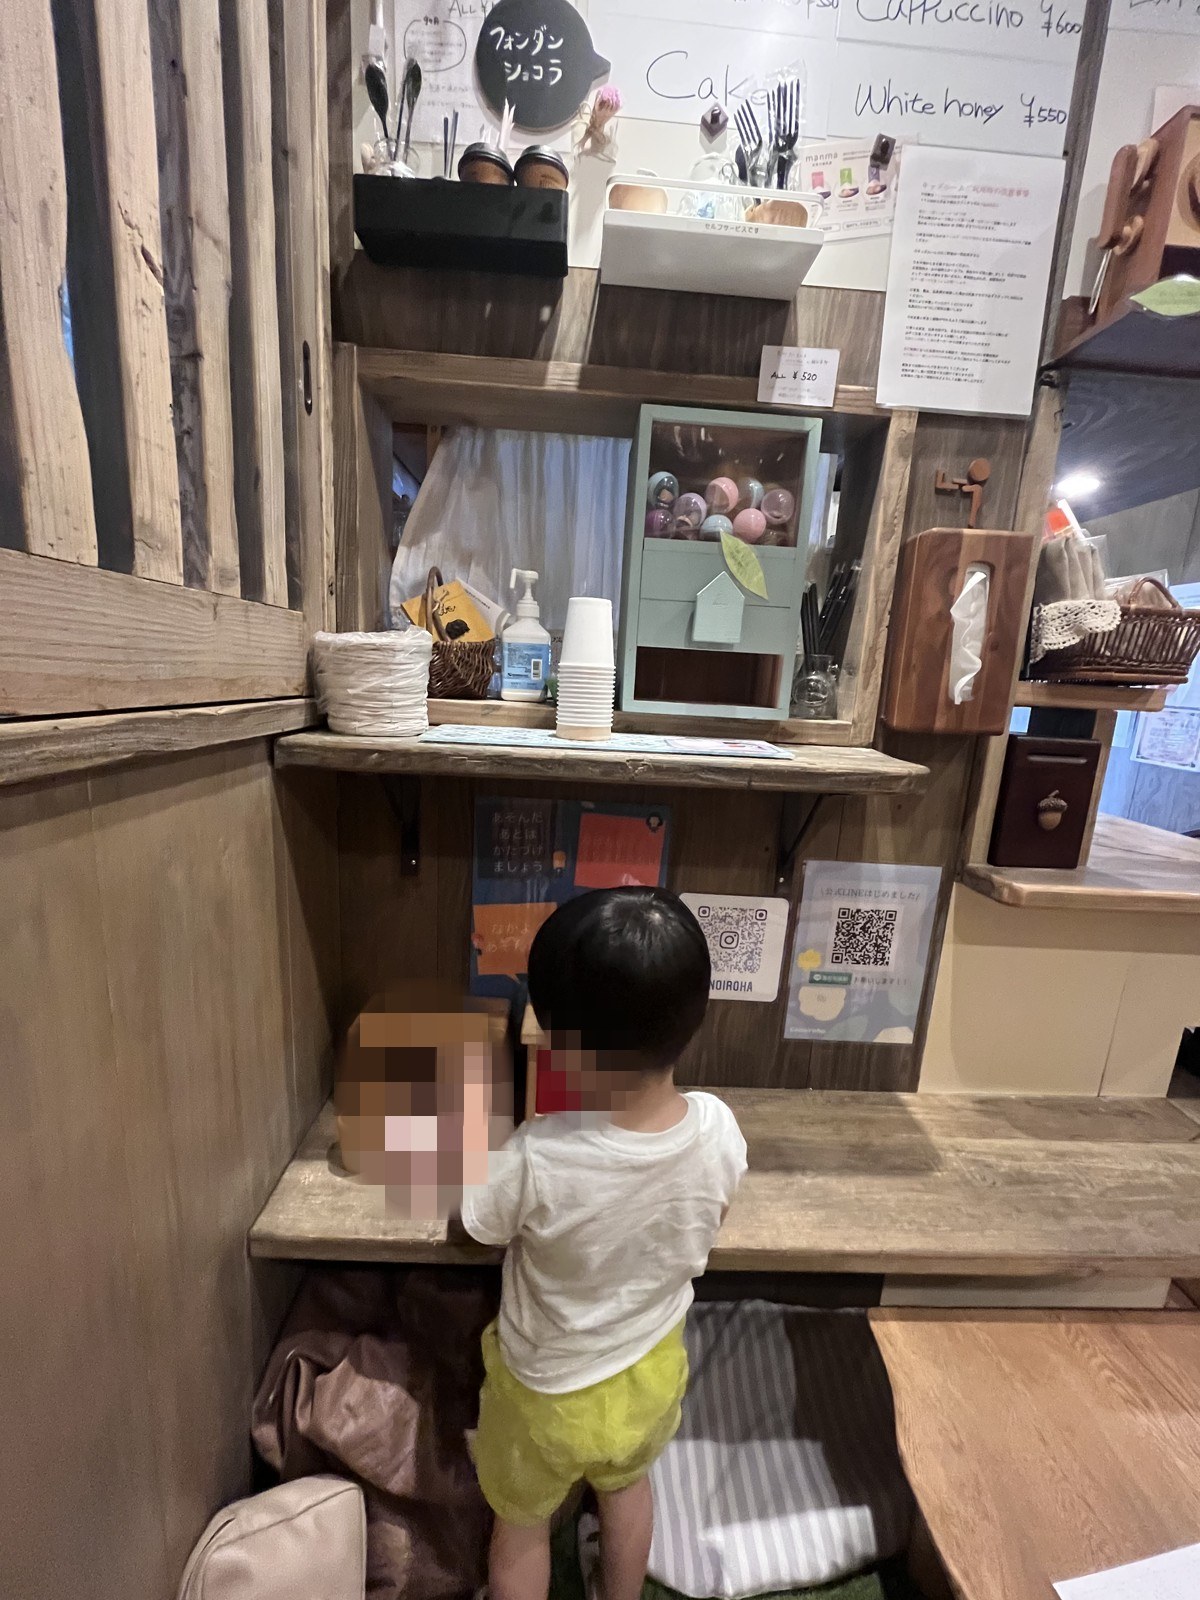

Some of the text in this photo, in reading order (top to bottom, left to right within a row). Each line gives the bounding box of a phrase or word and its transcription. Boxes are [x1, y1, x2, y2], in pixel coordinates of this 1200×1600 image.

[490, 25, 564, 56] フォンダン
[504, 59, 563, 85] ショコラ
[855, 79, 1067, 128] White honey ¥550
[805, 151, 838, 163] manma
[705, 223, 759, 234] セルフサービスです
[493, 860, 543, 873] ましょう
